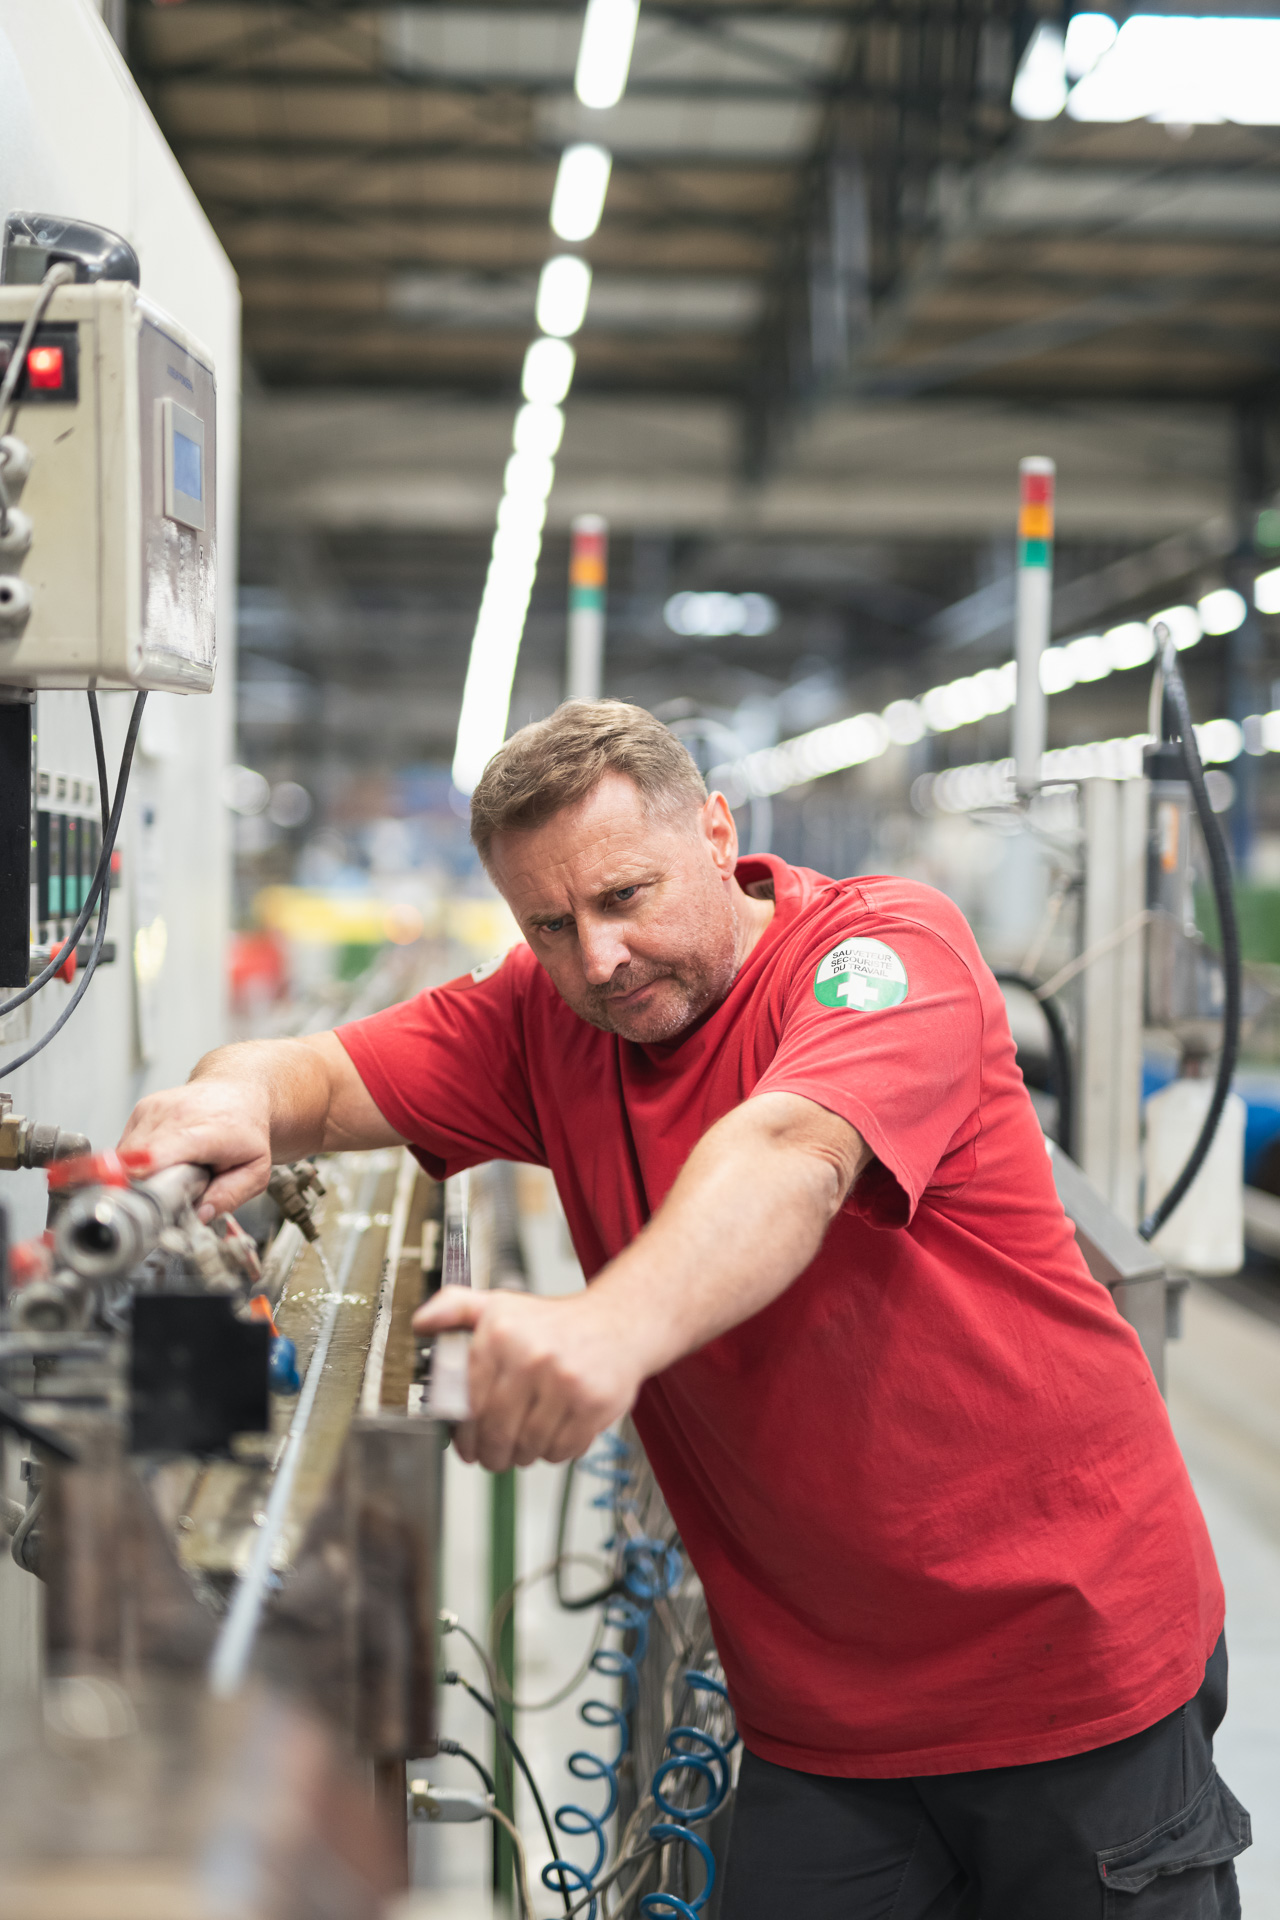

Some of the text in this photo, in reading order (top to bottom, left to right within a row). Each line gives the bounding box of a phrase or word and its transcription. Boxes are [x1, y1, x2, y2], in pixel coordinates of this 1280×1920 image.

[832, 949, 892, 962] SAUVETEUR
[831, 956, 893, 970] SECOURISTE
[833, 963, 889, 977] DU TRAVAIL
